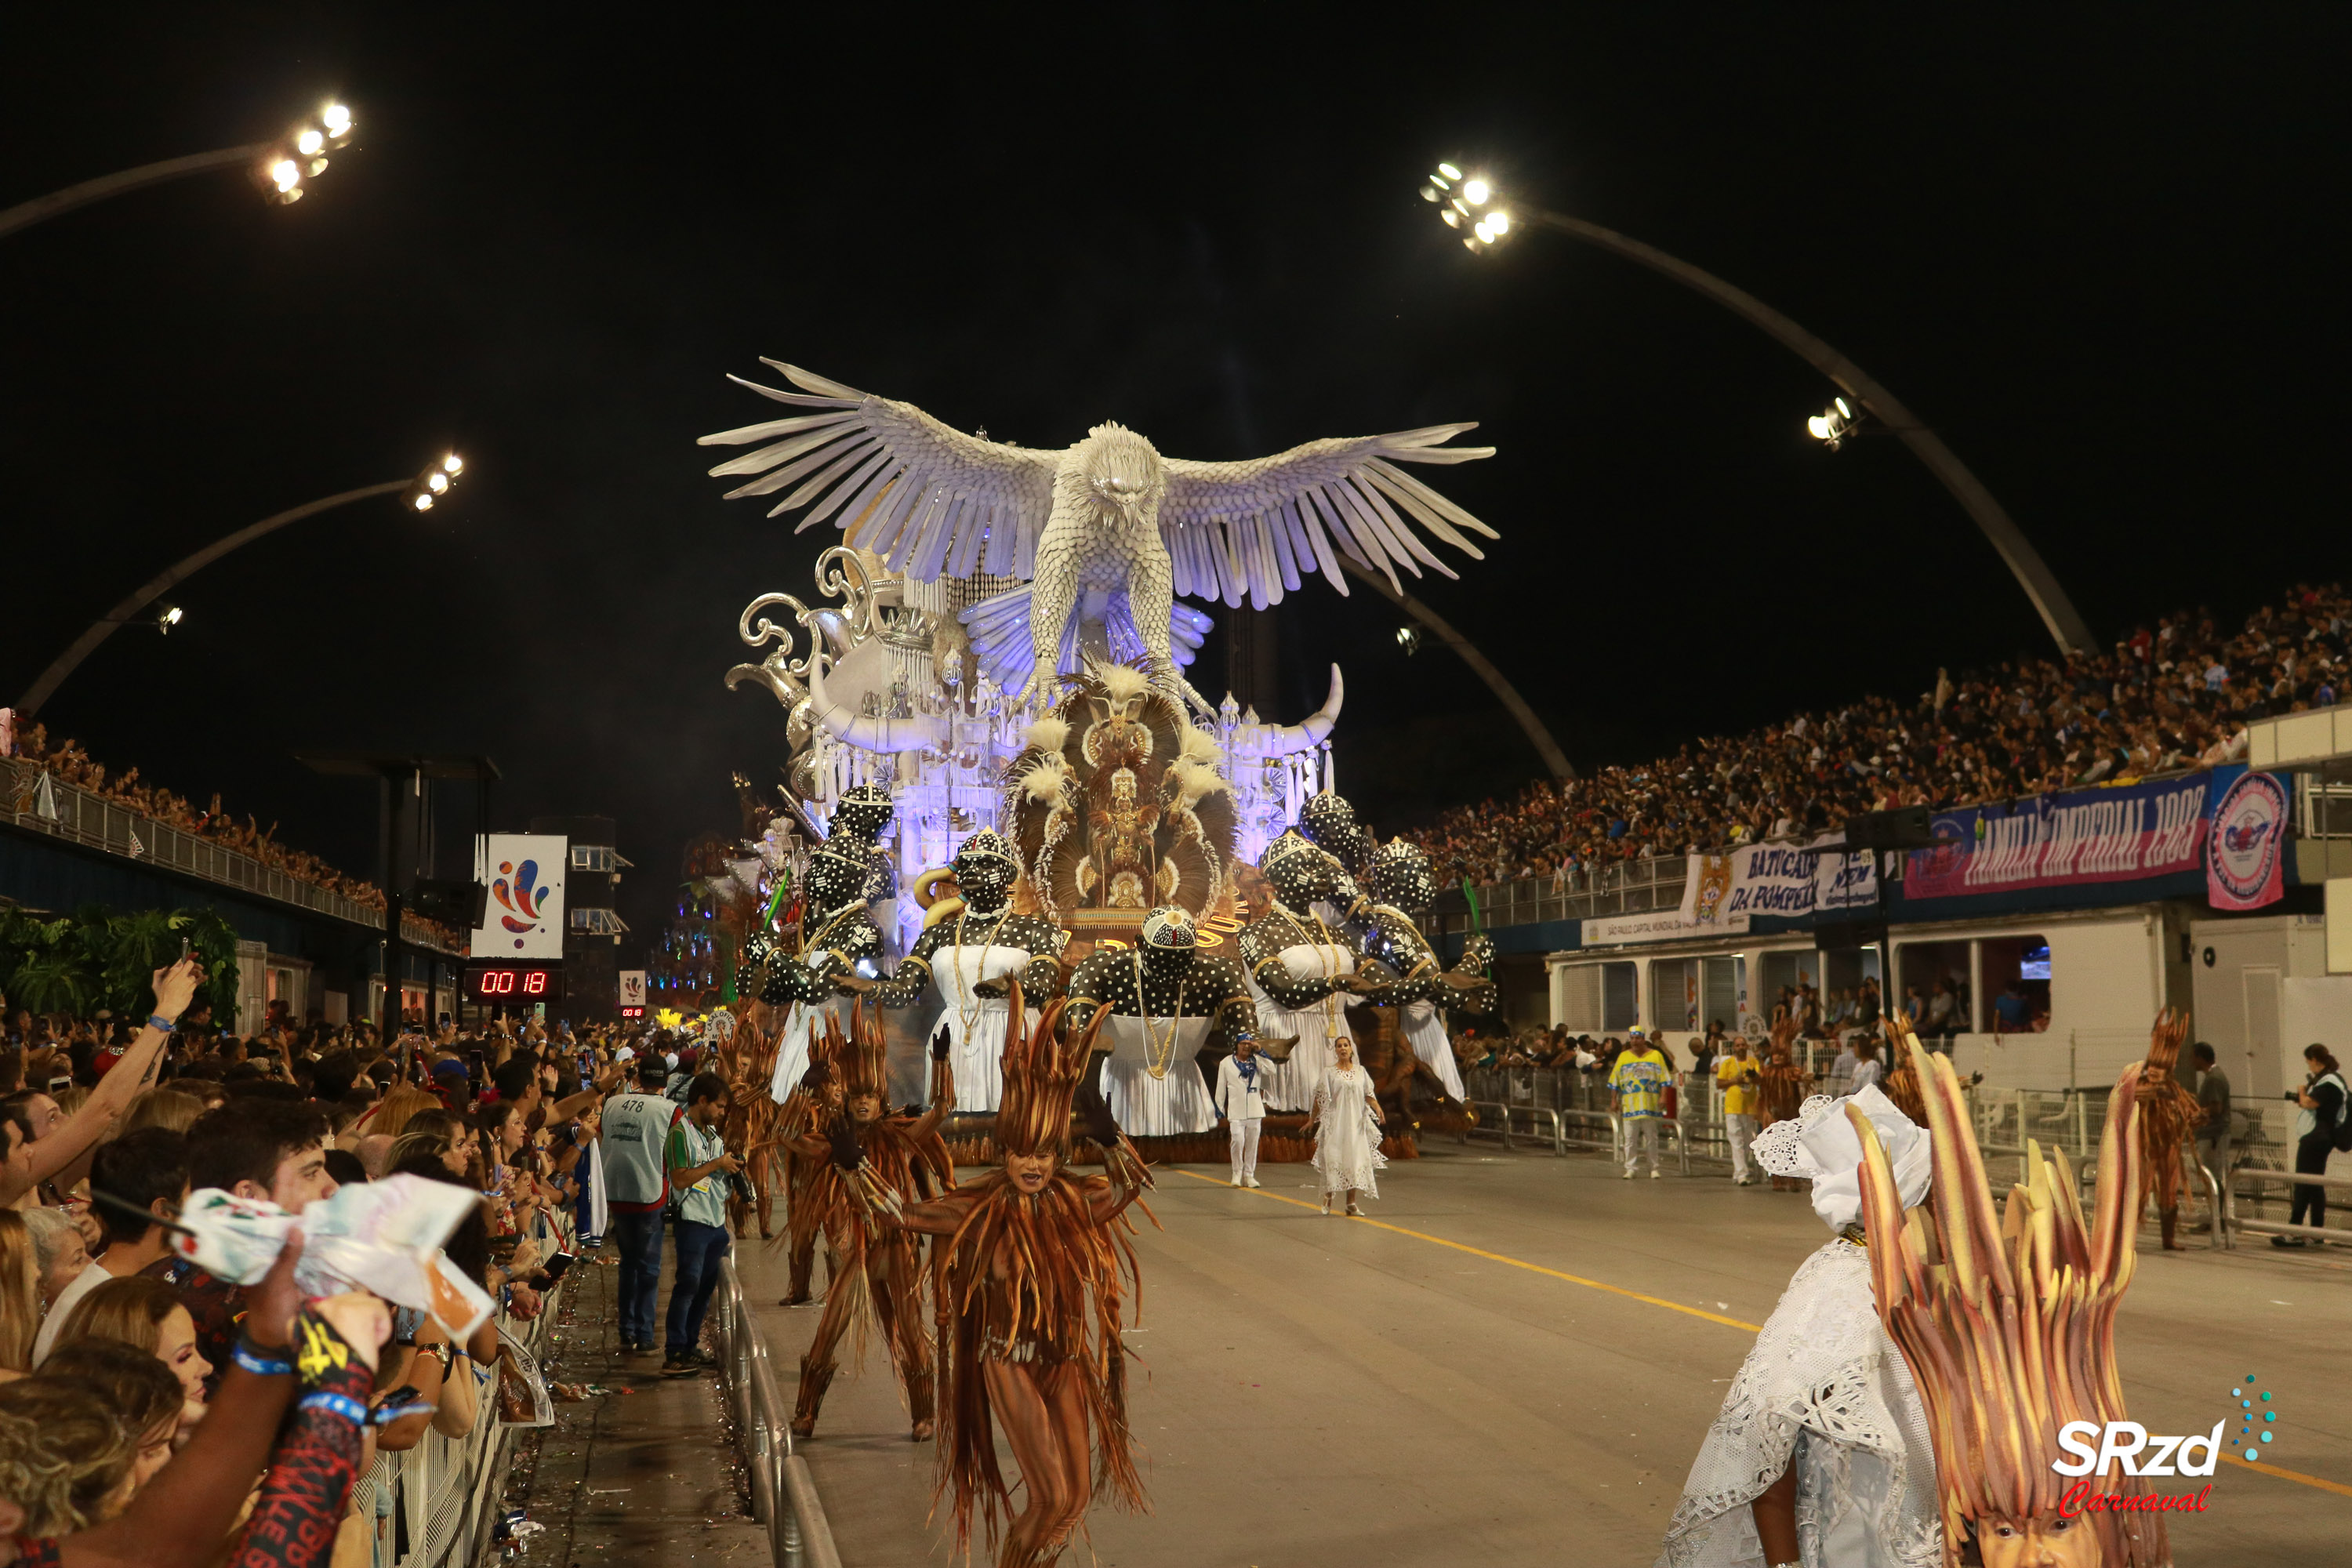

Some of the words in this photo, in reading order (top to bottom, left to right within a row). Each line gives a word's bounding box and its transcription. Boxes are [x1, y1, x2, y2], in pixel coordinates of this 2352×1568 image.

[2041, 797, 2147, 877] IMPERIAL
[2143, 784, 2205, 868] 1983
[1729, 887, 1754, 913] DA
[707, 1013, 718, 1031] CASAL
[622, 1099, 644, 1113] 478
